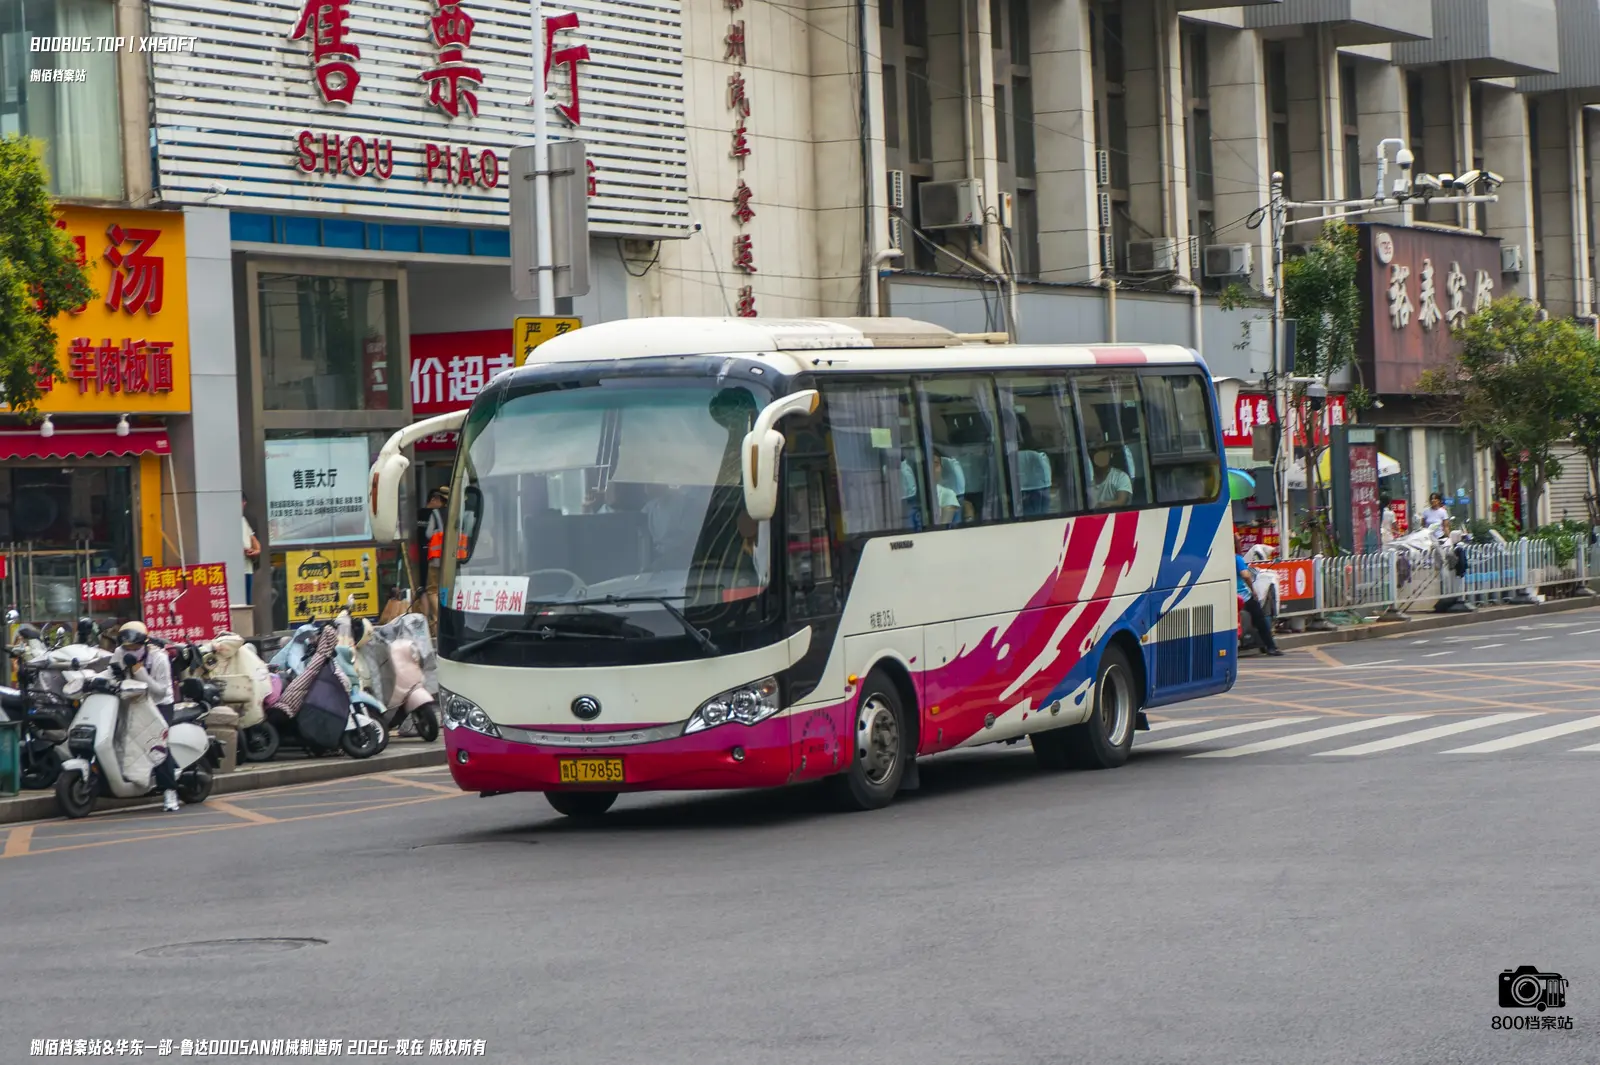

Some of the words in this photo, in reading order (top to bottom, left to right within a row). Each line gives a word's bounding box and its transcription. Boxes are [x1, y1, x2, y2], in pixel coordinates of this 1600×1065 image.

[298, 130, 394, 181] SHOU
[425, 143, 500, 189] PIAO
[723, 0, 758, 317] 州汽车客运站
[68, 337, 175, 393] 羊肉板面
[293, 468, 338, 490] 售票大厅
[82, 578, 129, 598] 空调开放
[144, 565, 225, 590] 淮南牛肉汤
